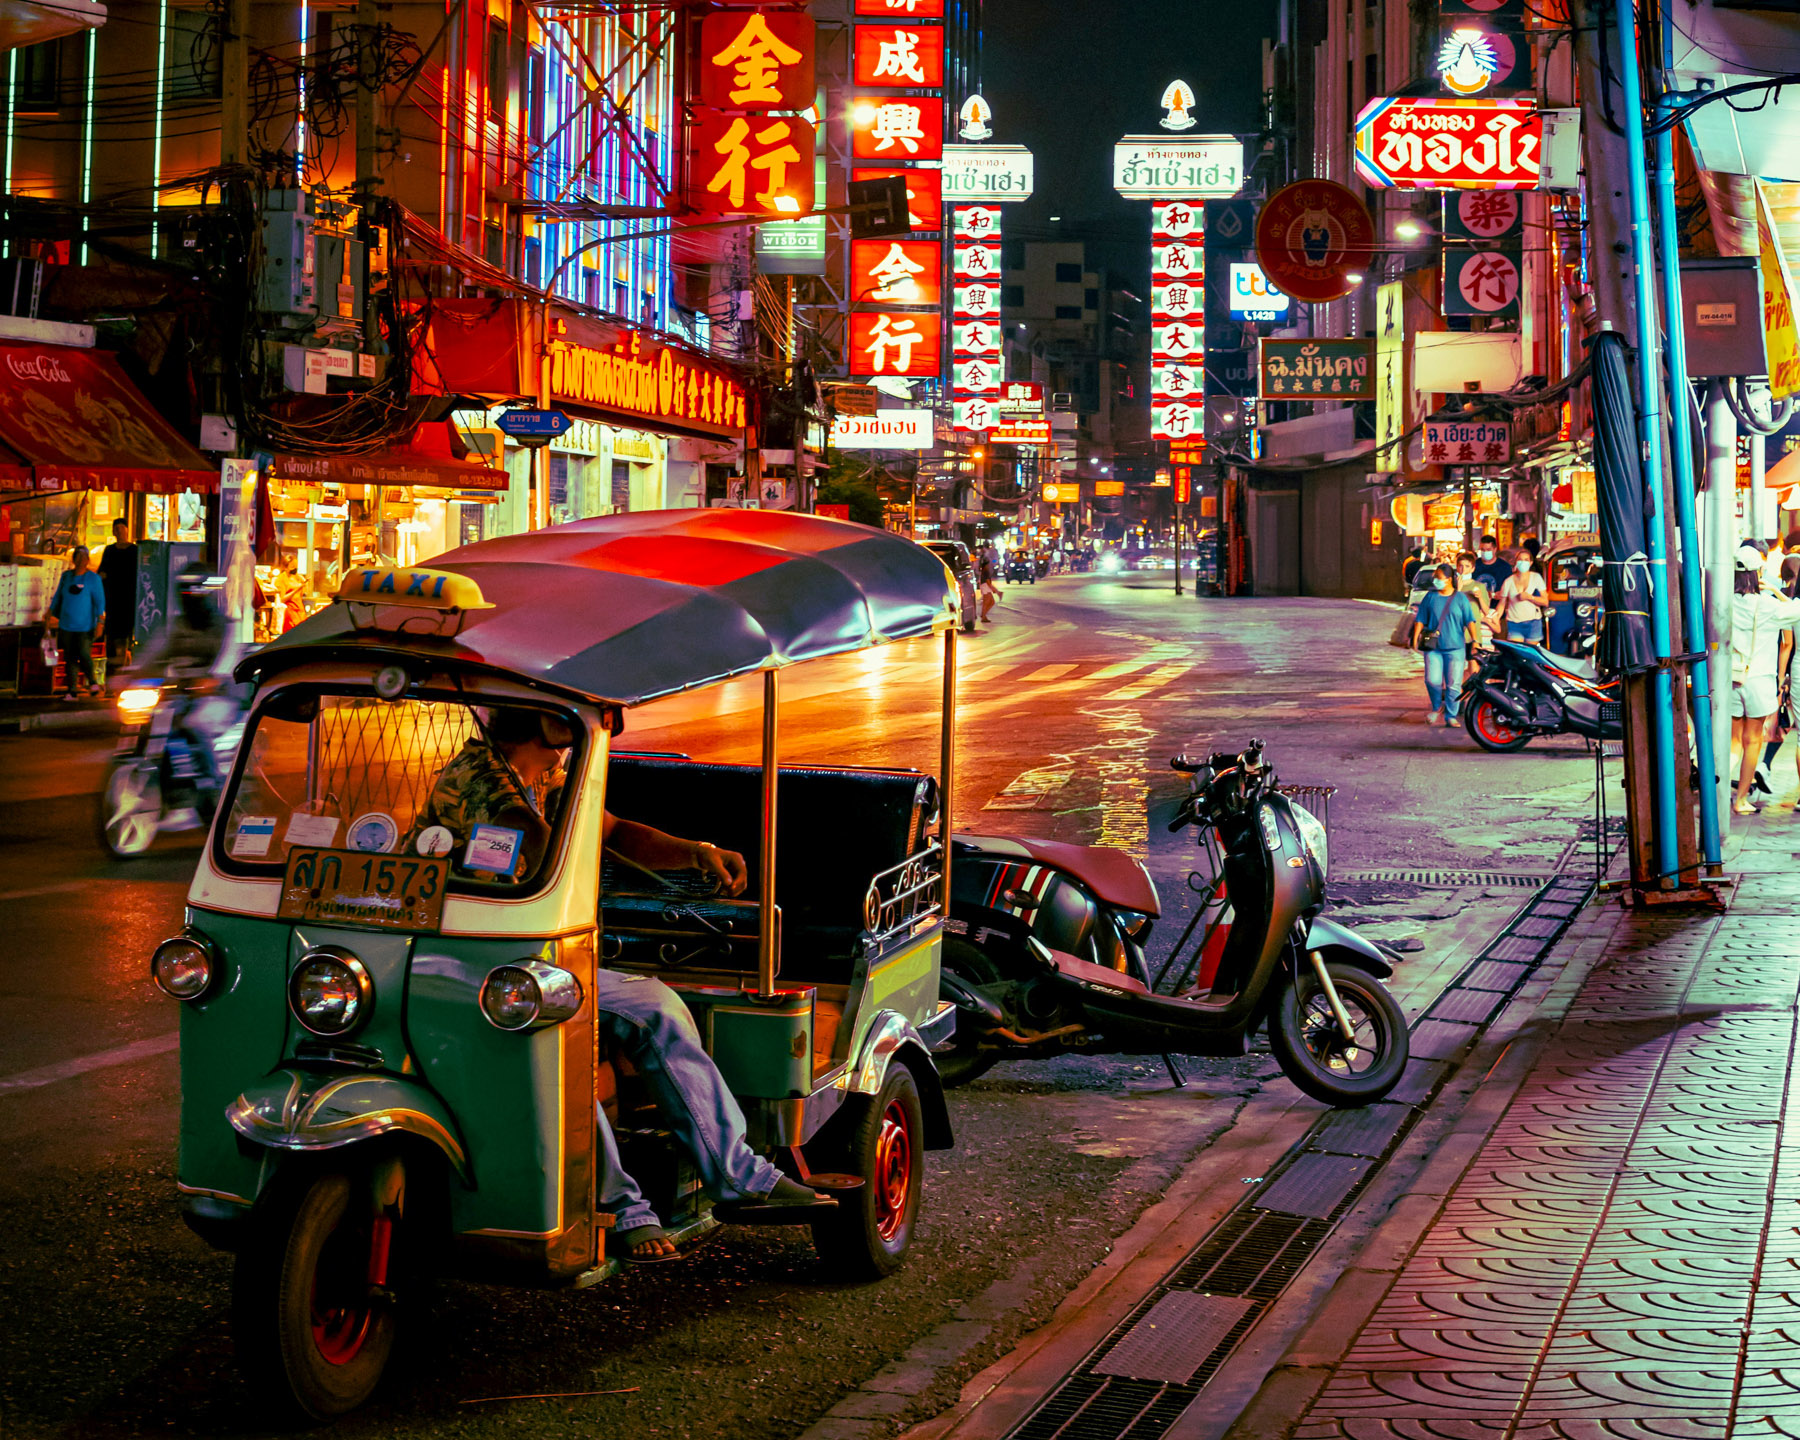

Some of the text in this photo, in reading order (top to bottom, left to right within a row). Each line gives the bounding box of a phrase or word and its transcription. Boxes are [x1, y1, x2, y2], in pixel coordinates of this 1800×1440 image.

[707, 13, 803, 210] 金行
[1389, 107, 1475, 131] ห้างทอง
[942, 167, 1027, 191] วเซ่งเฮง
[1122, 153, 1236, 186] ฮั่วเซ่งเฮง
[864, 0, 925, 373] 成興金行
[763, 236, 818, 246] WISDOM
[965, 211, 990, 427] 和成興大金行
[1164, 206, 1191, 433] 和成興大金行
[1252, 311, 1276, 321] 1428
[1268, 343, 1367, 377] ฉ.มั่นคง
[551, 416, 560, 429] 6
[1577, 535, 1596, 543] TAXI
[361, 570, 448, 598] TAXI
[361, 858, 439, 899] 1573
